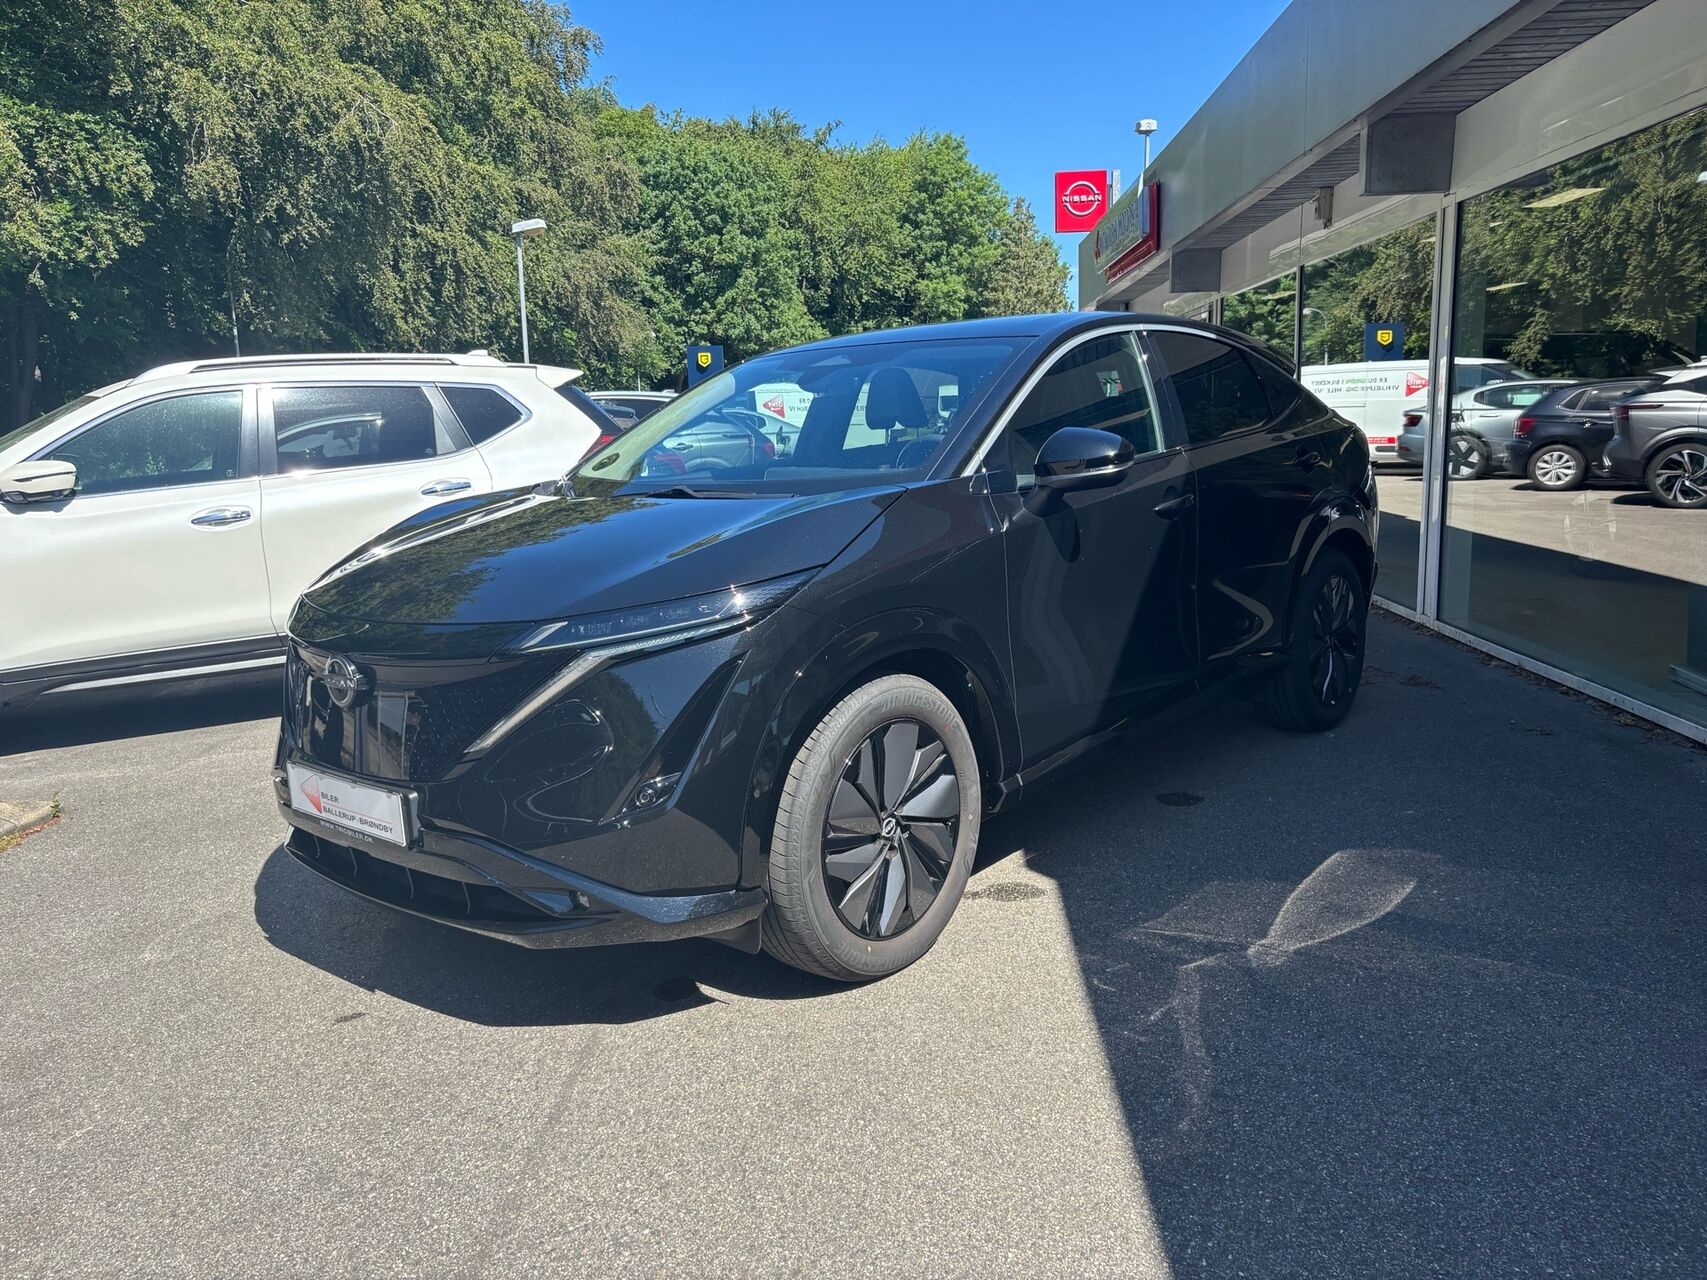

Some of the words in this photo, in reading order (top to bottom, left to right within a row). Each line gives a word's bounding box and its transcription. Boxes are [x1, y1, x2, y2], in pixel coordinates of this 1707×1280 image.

[1061, 194, 1102, 203] NISSAN
[881, 692, 959, 728] BRIDGESTONE
[321, 791, 339, 803] BILER
